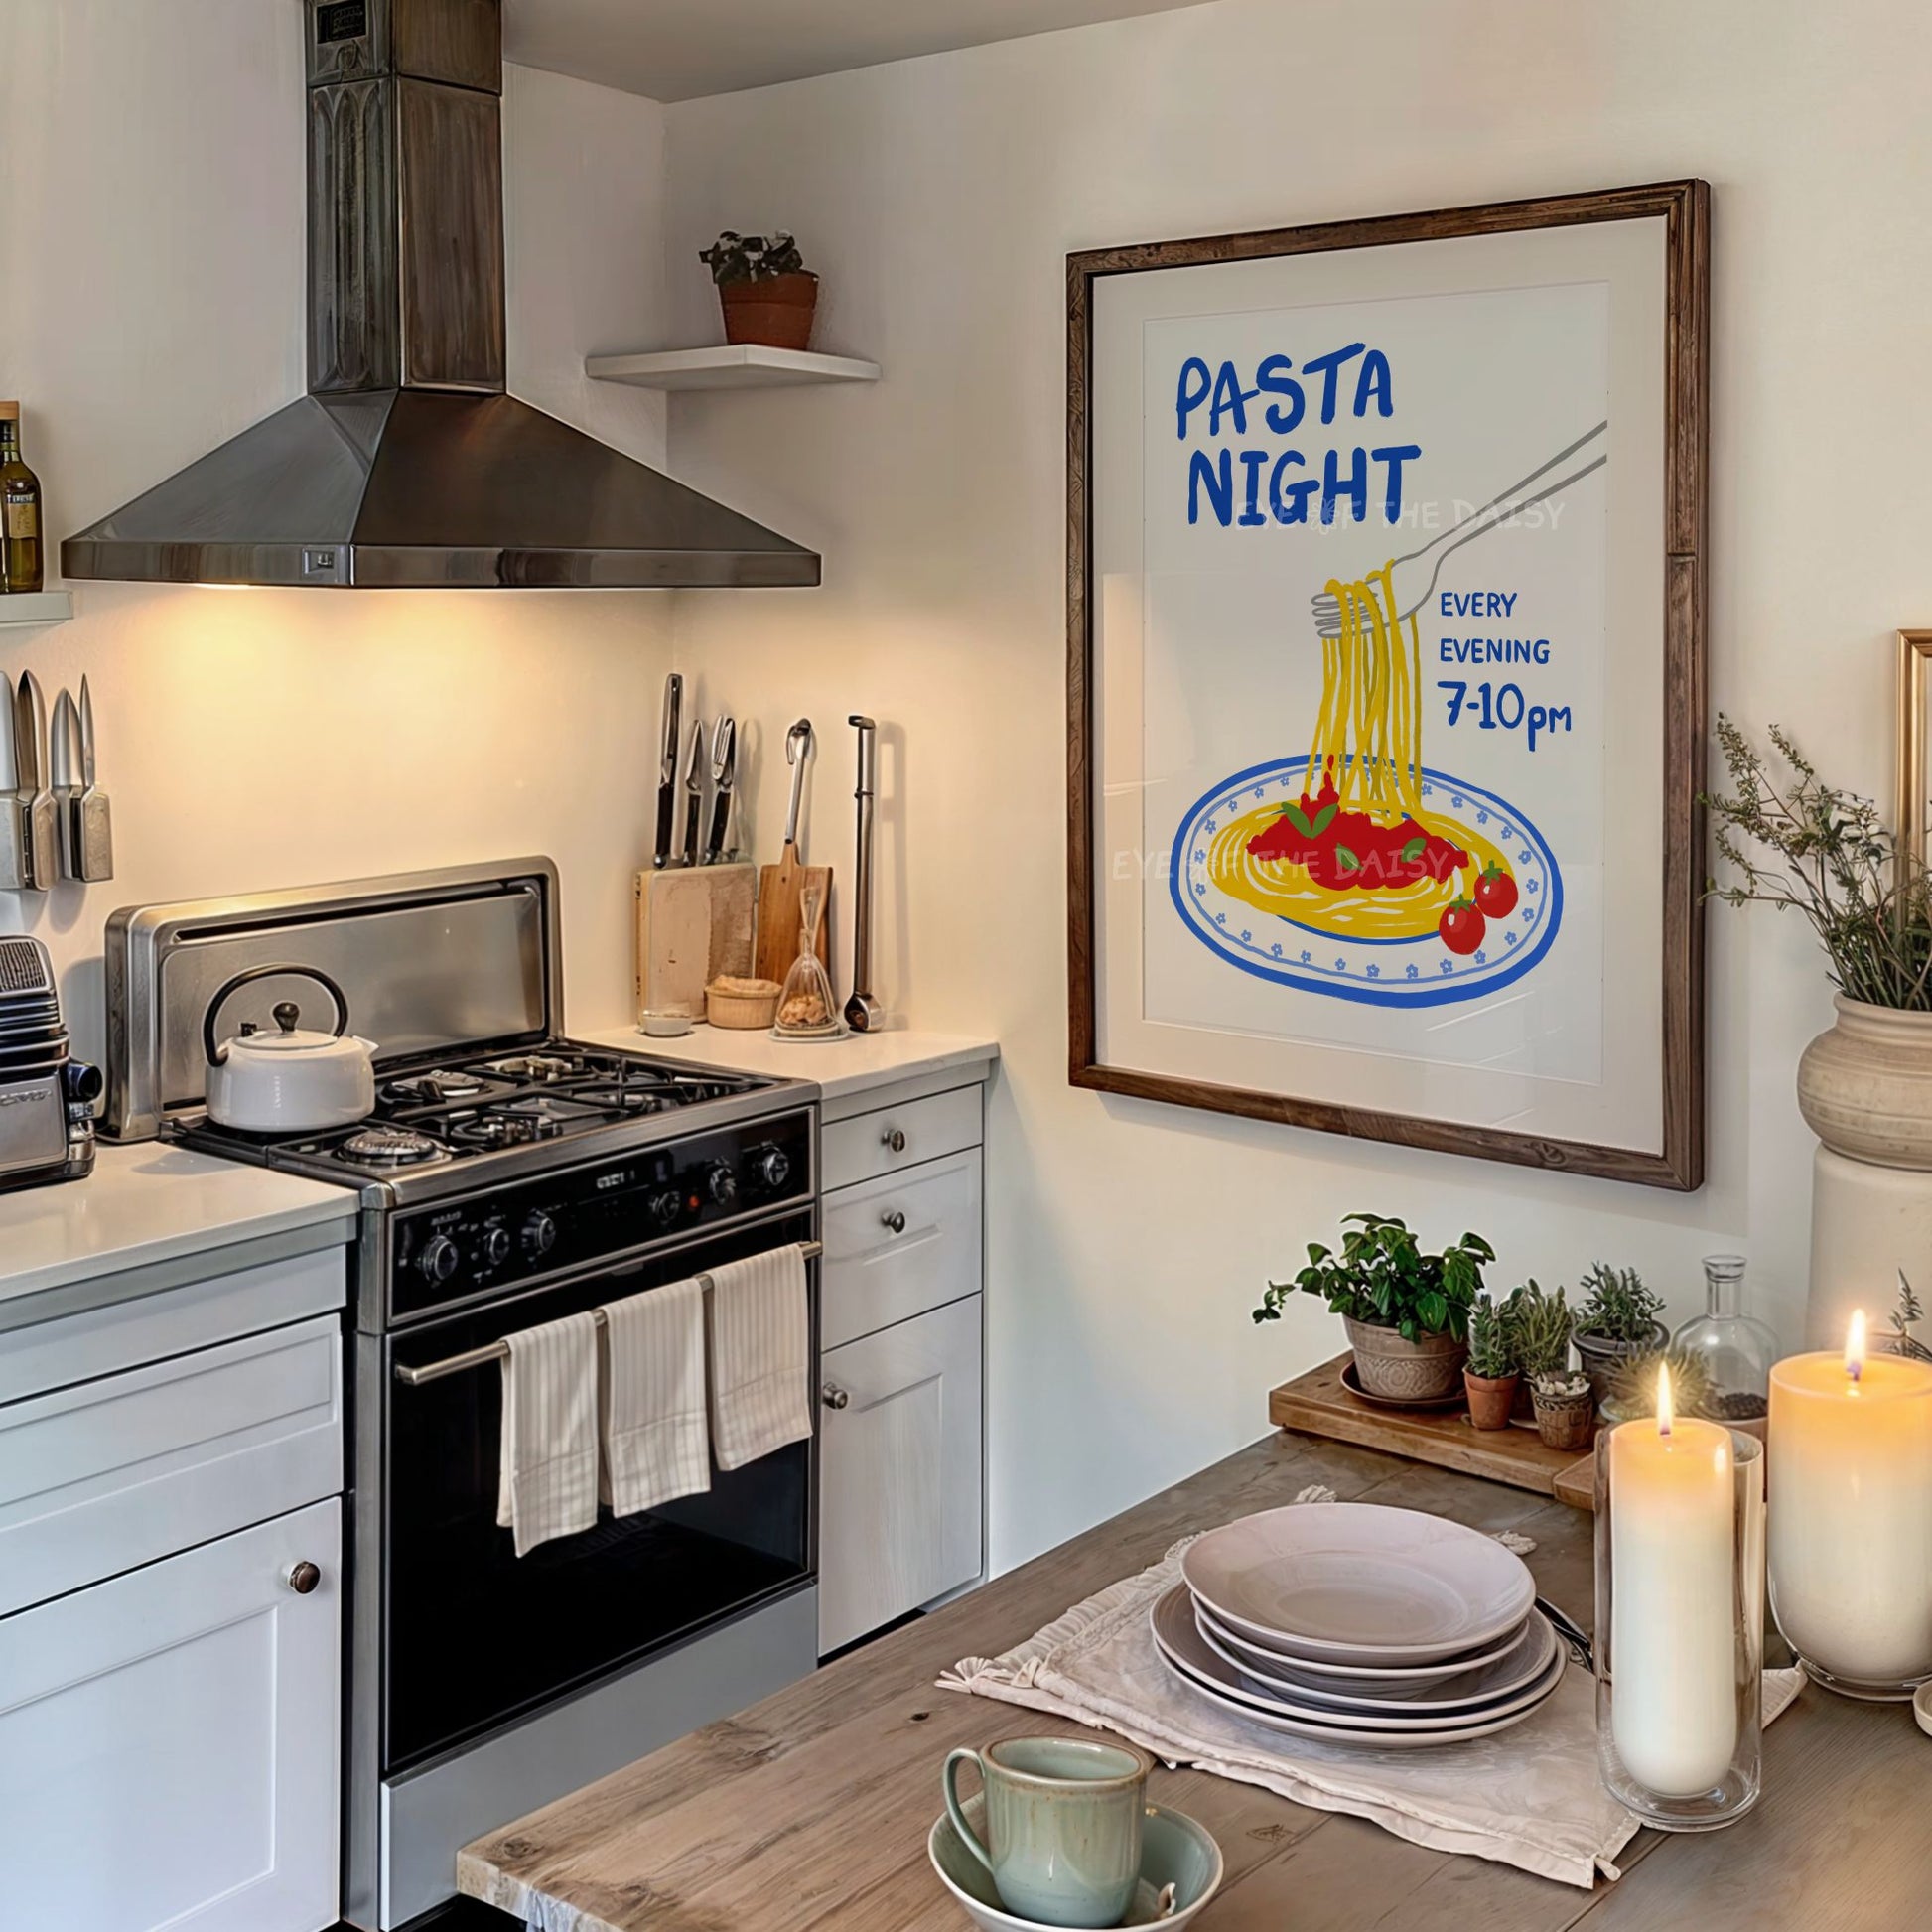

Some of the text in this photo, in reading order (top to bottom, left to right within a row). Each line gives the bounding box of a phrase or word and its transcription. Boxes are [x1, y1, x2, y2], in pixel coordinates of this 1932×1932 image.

[1176, 343, 1394, 440] PASTA
[1187, 444, 1422, 527] NIGHT
[1441, 591, 1518, 618] EVERY
[1440, 637, 1550, 665] EVENING
